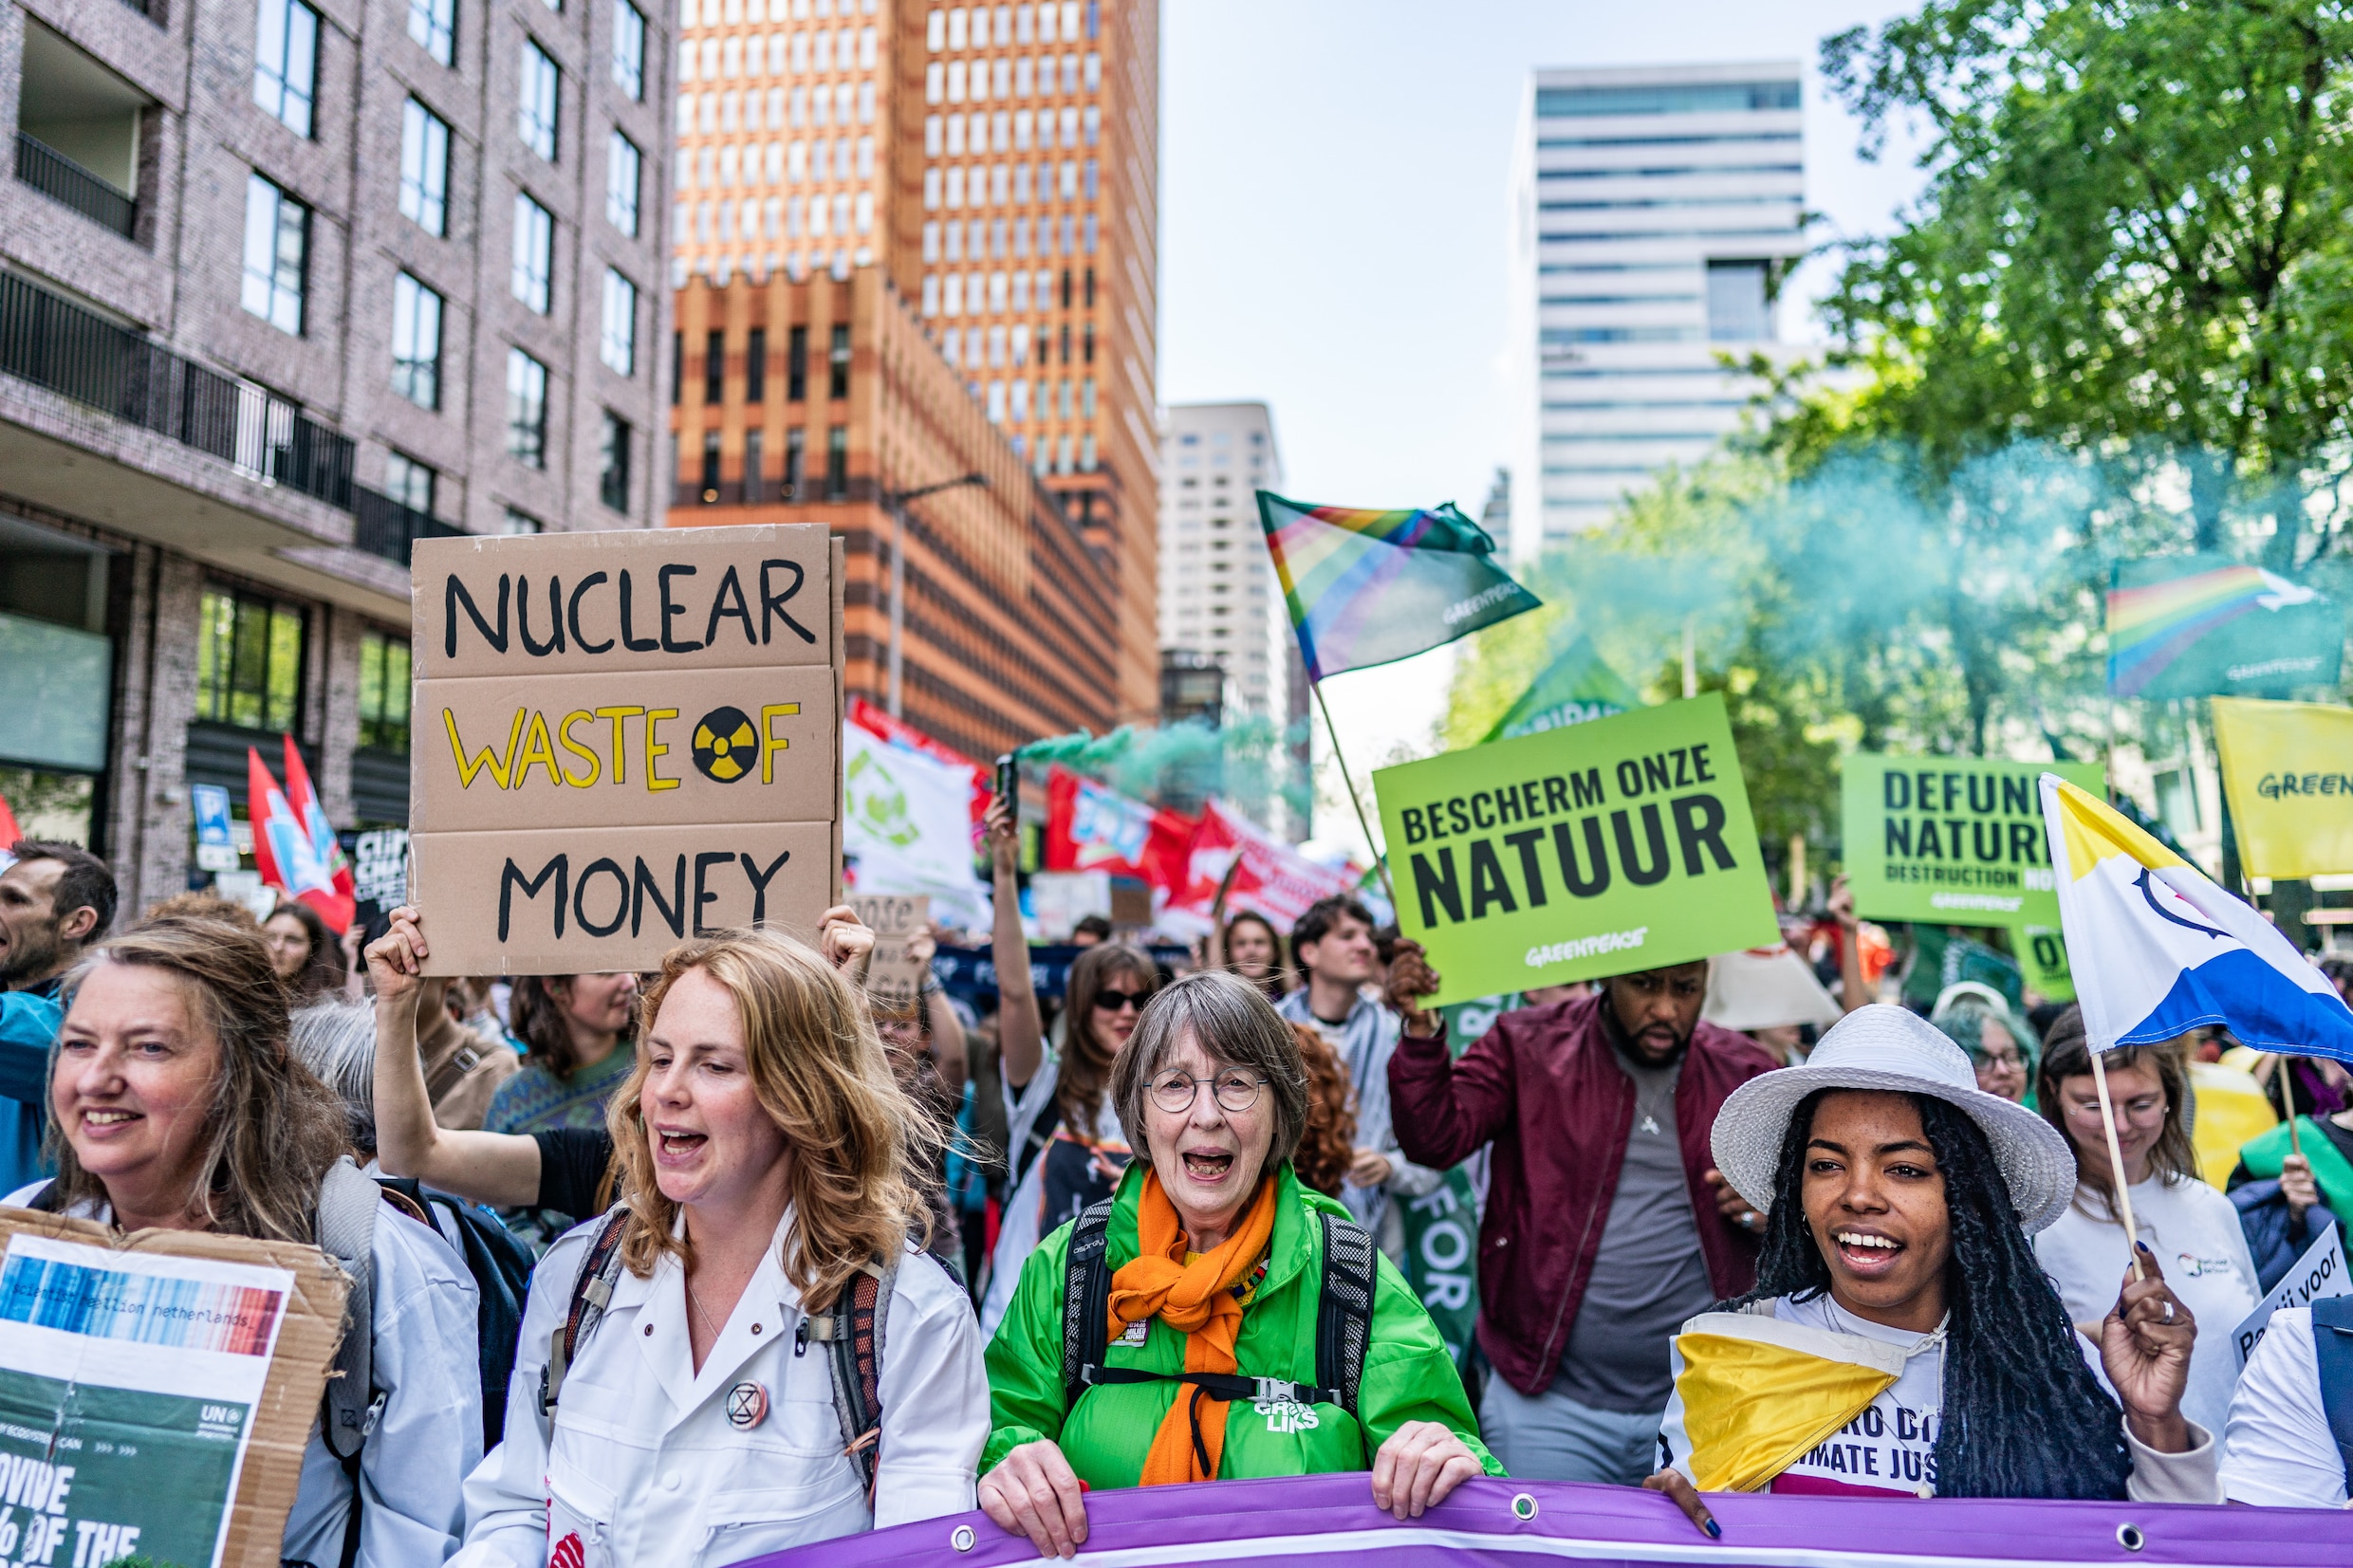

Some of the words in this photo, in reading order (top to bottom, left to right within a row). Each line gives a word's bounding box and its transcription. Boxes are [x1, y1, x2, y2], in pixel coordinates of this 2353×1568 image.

[445, 559, 816, 658] NUCLEAR
[442, 705, 681, 793] WASTE
[1401, 767, 1605, 846] BESCHERM
[1617, 743, 1716, 799] ONZE
[1883, 771, 2044, 817] DEFUN
[1410, 794, 1738, 930] NATUUR
[1885, 817, 2053, 866] NATUR
[1885, 863, 2019, 889] DESTRUCTION
[2024, 867, 2057, 893] NO
[497, 850, 790, 943] MONEY
[1525, 926, 1649, 968] GREENPEACE
[2298, 1245, 2338, 1303] voor
